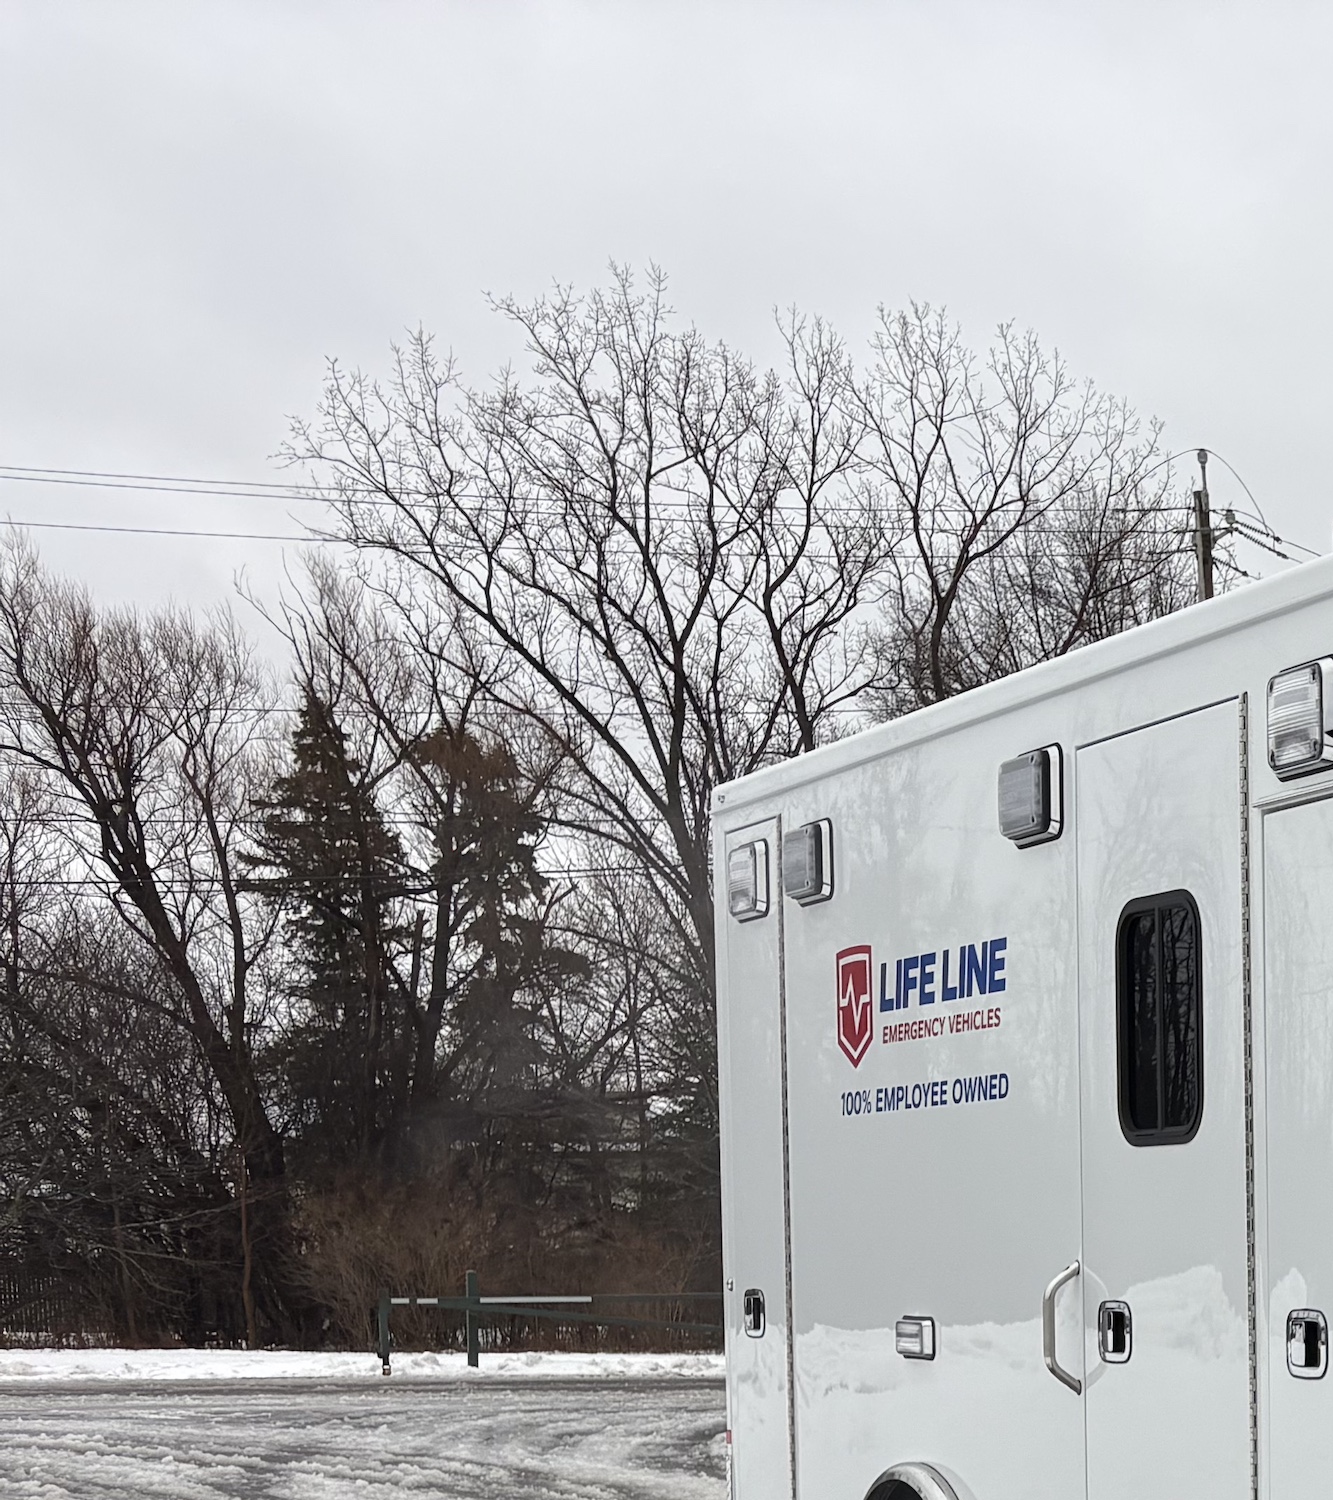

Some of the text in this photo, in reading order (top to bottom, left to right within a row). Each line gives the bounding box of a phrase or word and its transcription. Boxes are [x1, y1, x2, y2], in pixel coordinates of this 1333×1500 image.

[879, 936, 1008, 1013] LIFE LINE
[882, 1007, 1002, 1045] EMERGENCY VEHICLES
[841, 1072, 1009, 1116] 100% EMPLOYEE OWNED
